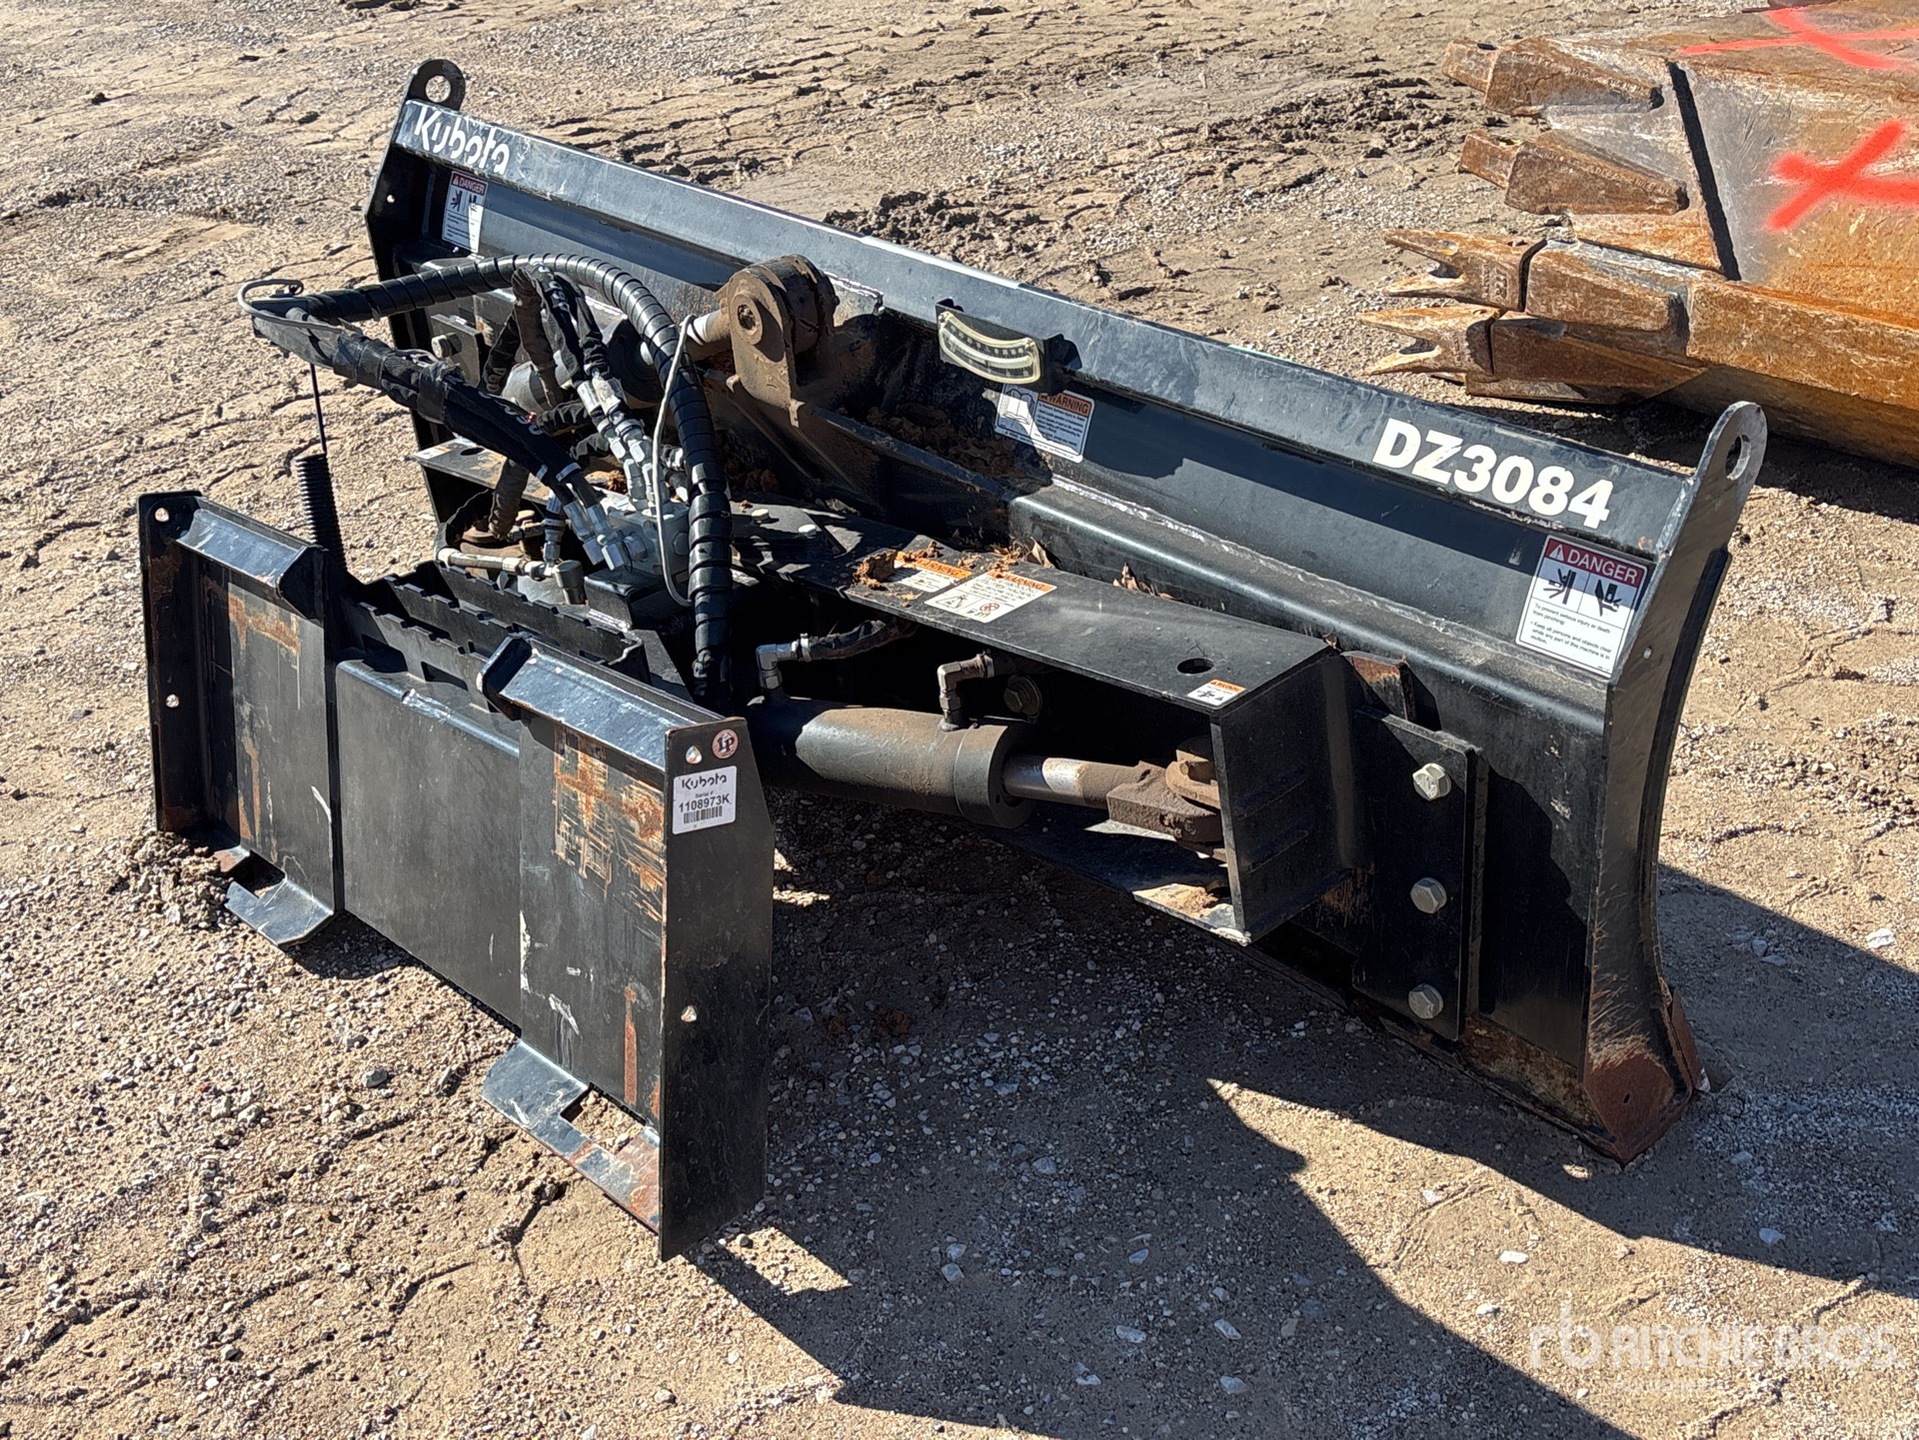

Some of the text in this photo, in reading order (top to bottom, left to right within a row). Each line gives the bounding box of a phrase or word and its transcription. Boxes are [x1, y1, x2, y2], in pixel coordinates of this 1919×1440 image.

[414, 107, 510, 175] Kubota
[459, 177, 485, 194] DANGER
[1372, 418, 1614, 529] DZ3084
[1567, 549, 1638, 585] DANGER
[1577, 618, 1590, 628] injury
[682, 773, 727, 790] Kubota
[679, 793, 730, 813] 1108973K
